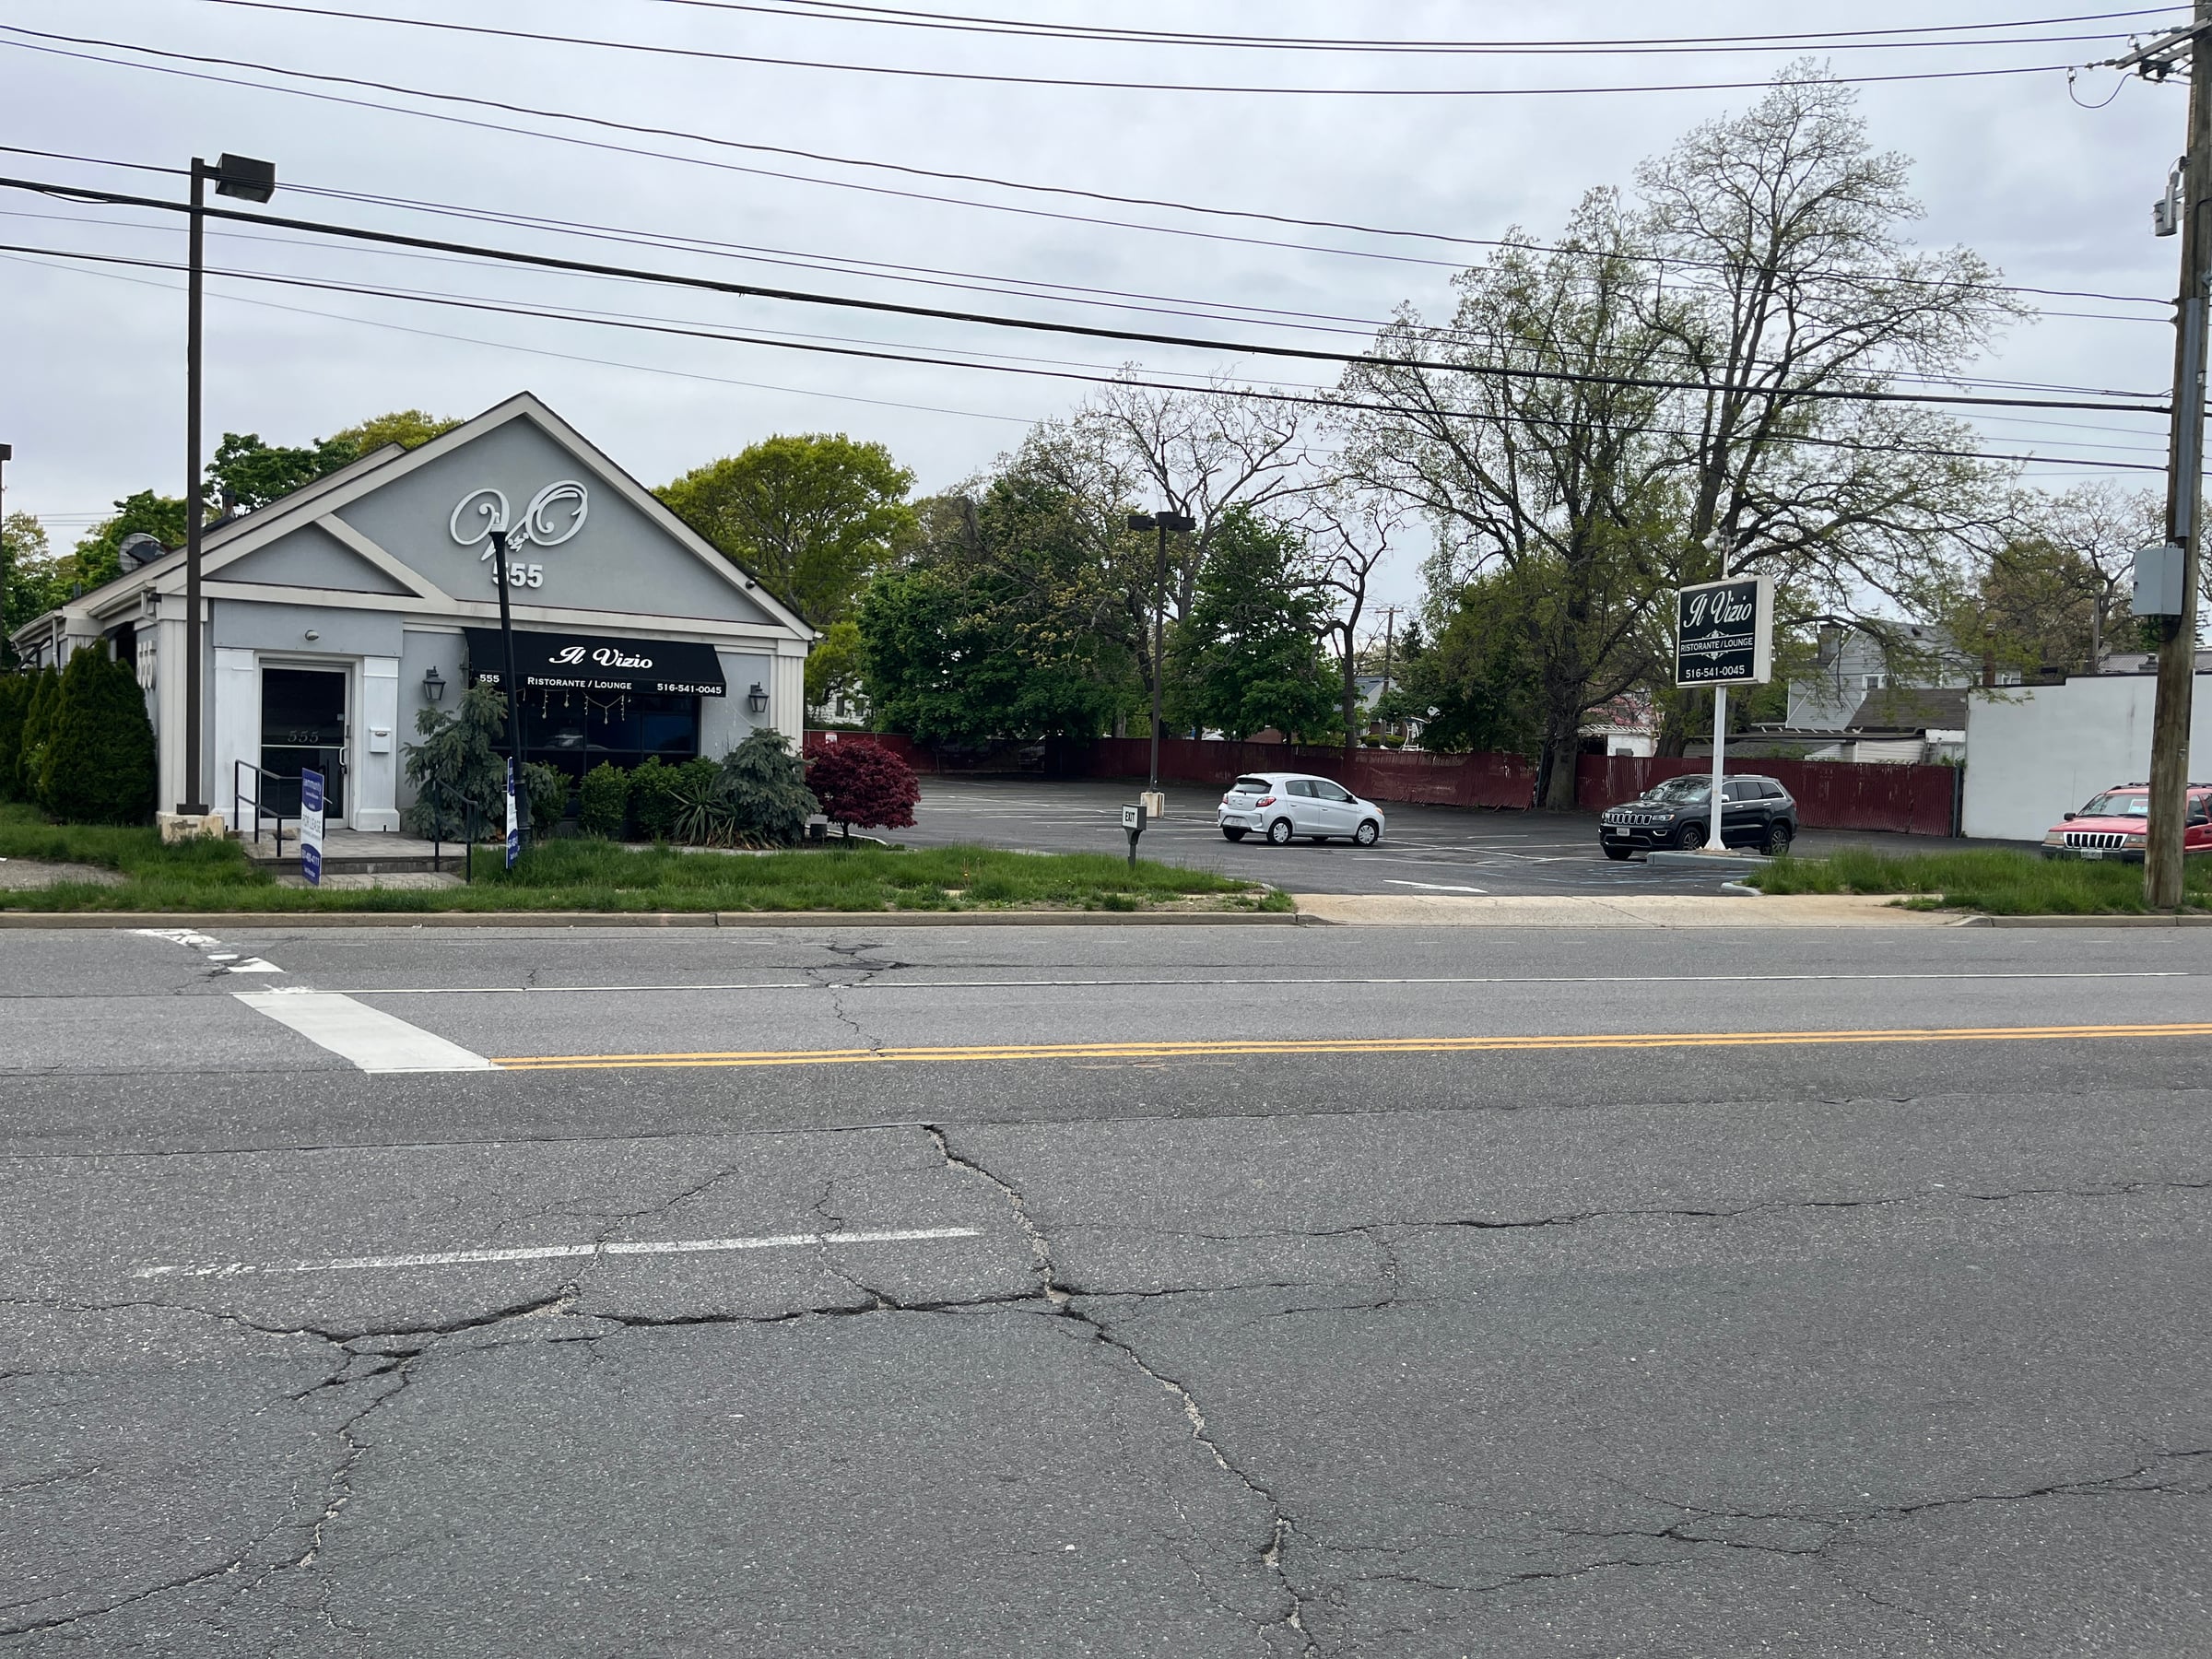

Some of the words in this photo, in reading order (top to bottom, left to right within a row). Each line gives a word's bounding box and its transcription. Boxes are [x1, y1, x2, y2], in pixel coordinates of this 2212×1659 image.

[1683, 594, 1708, 628] Il
[1711, 590, 1752, 624] Vizio
[1680, 641, 1720, 653] RISTORANTE
[1724, 637, 1753, 648] LOUNGE
[548, 646, 586, 665] Il
[593, 648, 653, 669] Vizio
[1685, 665, 1745, 678] 516-541-0045
[479, 674, 500, 683] 555
[656, 683, 722, 694] 516-541-0045
[288, 730, 319, 744] 555
[1125, 811, 1135, 822] EXIT
